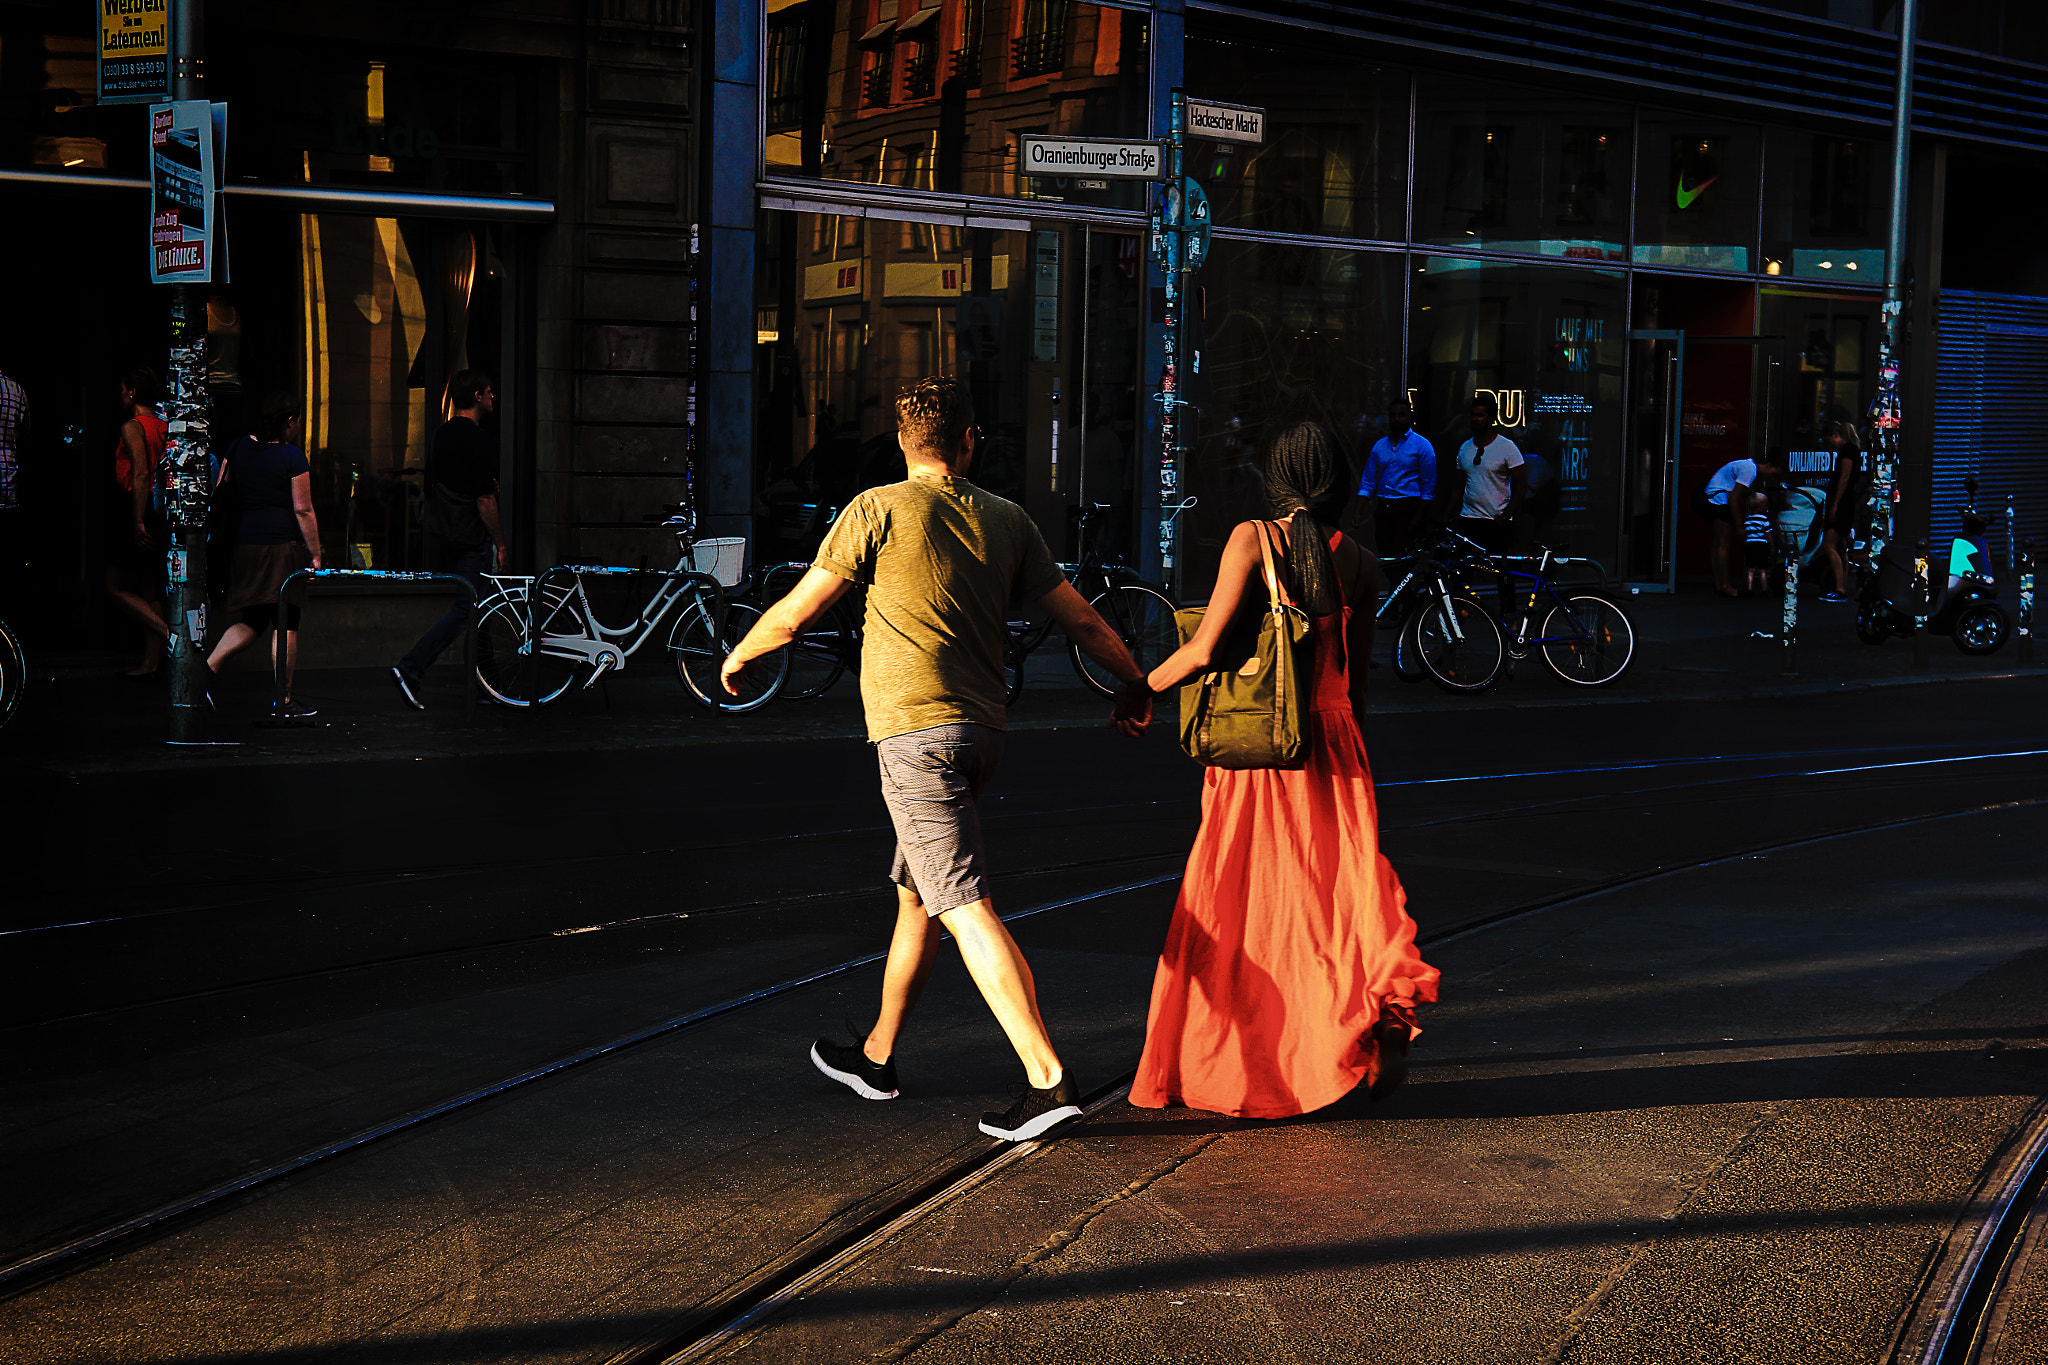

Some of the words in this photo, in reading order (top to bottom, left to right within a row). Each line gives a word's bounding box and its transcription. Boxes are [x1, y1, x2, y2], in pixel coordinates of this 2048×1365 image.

[103, 24, 165, 50] Laternen!
[1191, 107, 1234, 131] Hackescher
[1236, 114, 1259, 134] Markt
[1032, 143, 1118, 170] Oranienburger
[1119, 148, 1156, 171] Straße
[166, 213, 177, 227] Zug
[158, 250, 168, 269] DIE
[1555, 317, 1582, 341] LAUF
[1585, 319, 1604, 342] MIT
[1568, 348, 1589, 372] UNS
[1682, 424, 1727, 436] RUNNING
[1561, 447, 1588, 480] NRC
[1789, 451, 1831, 472] UNLIMITED
